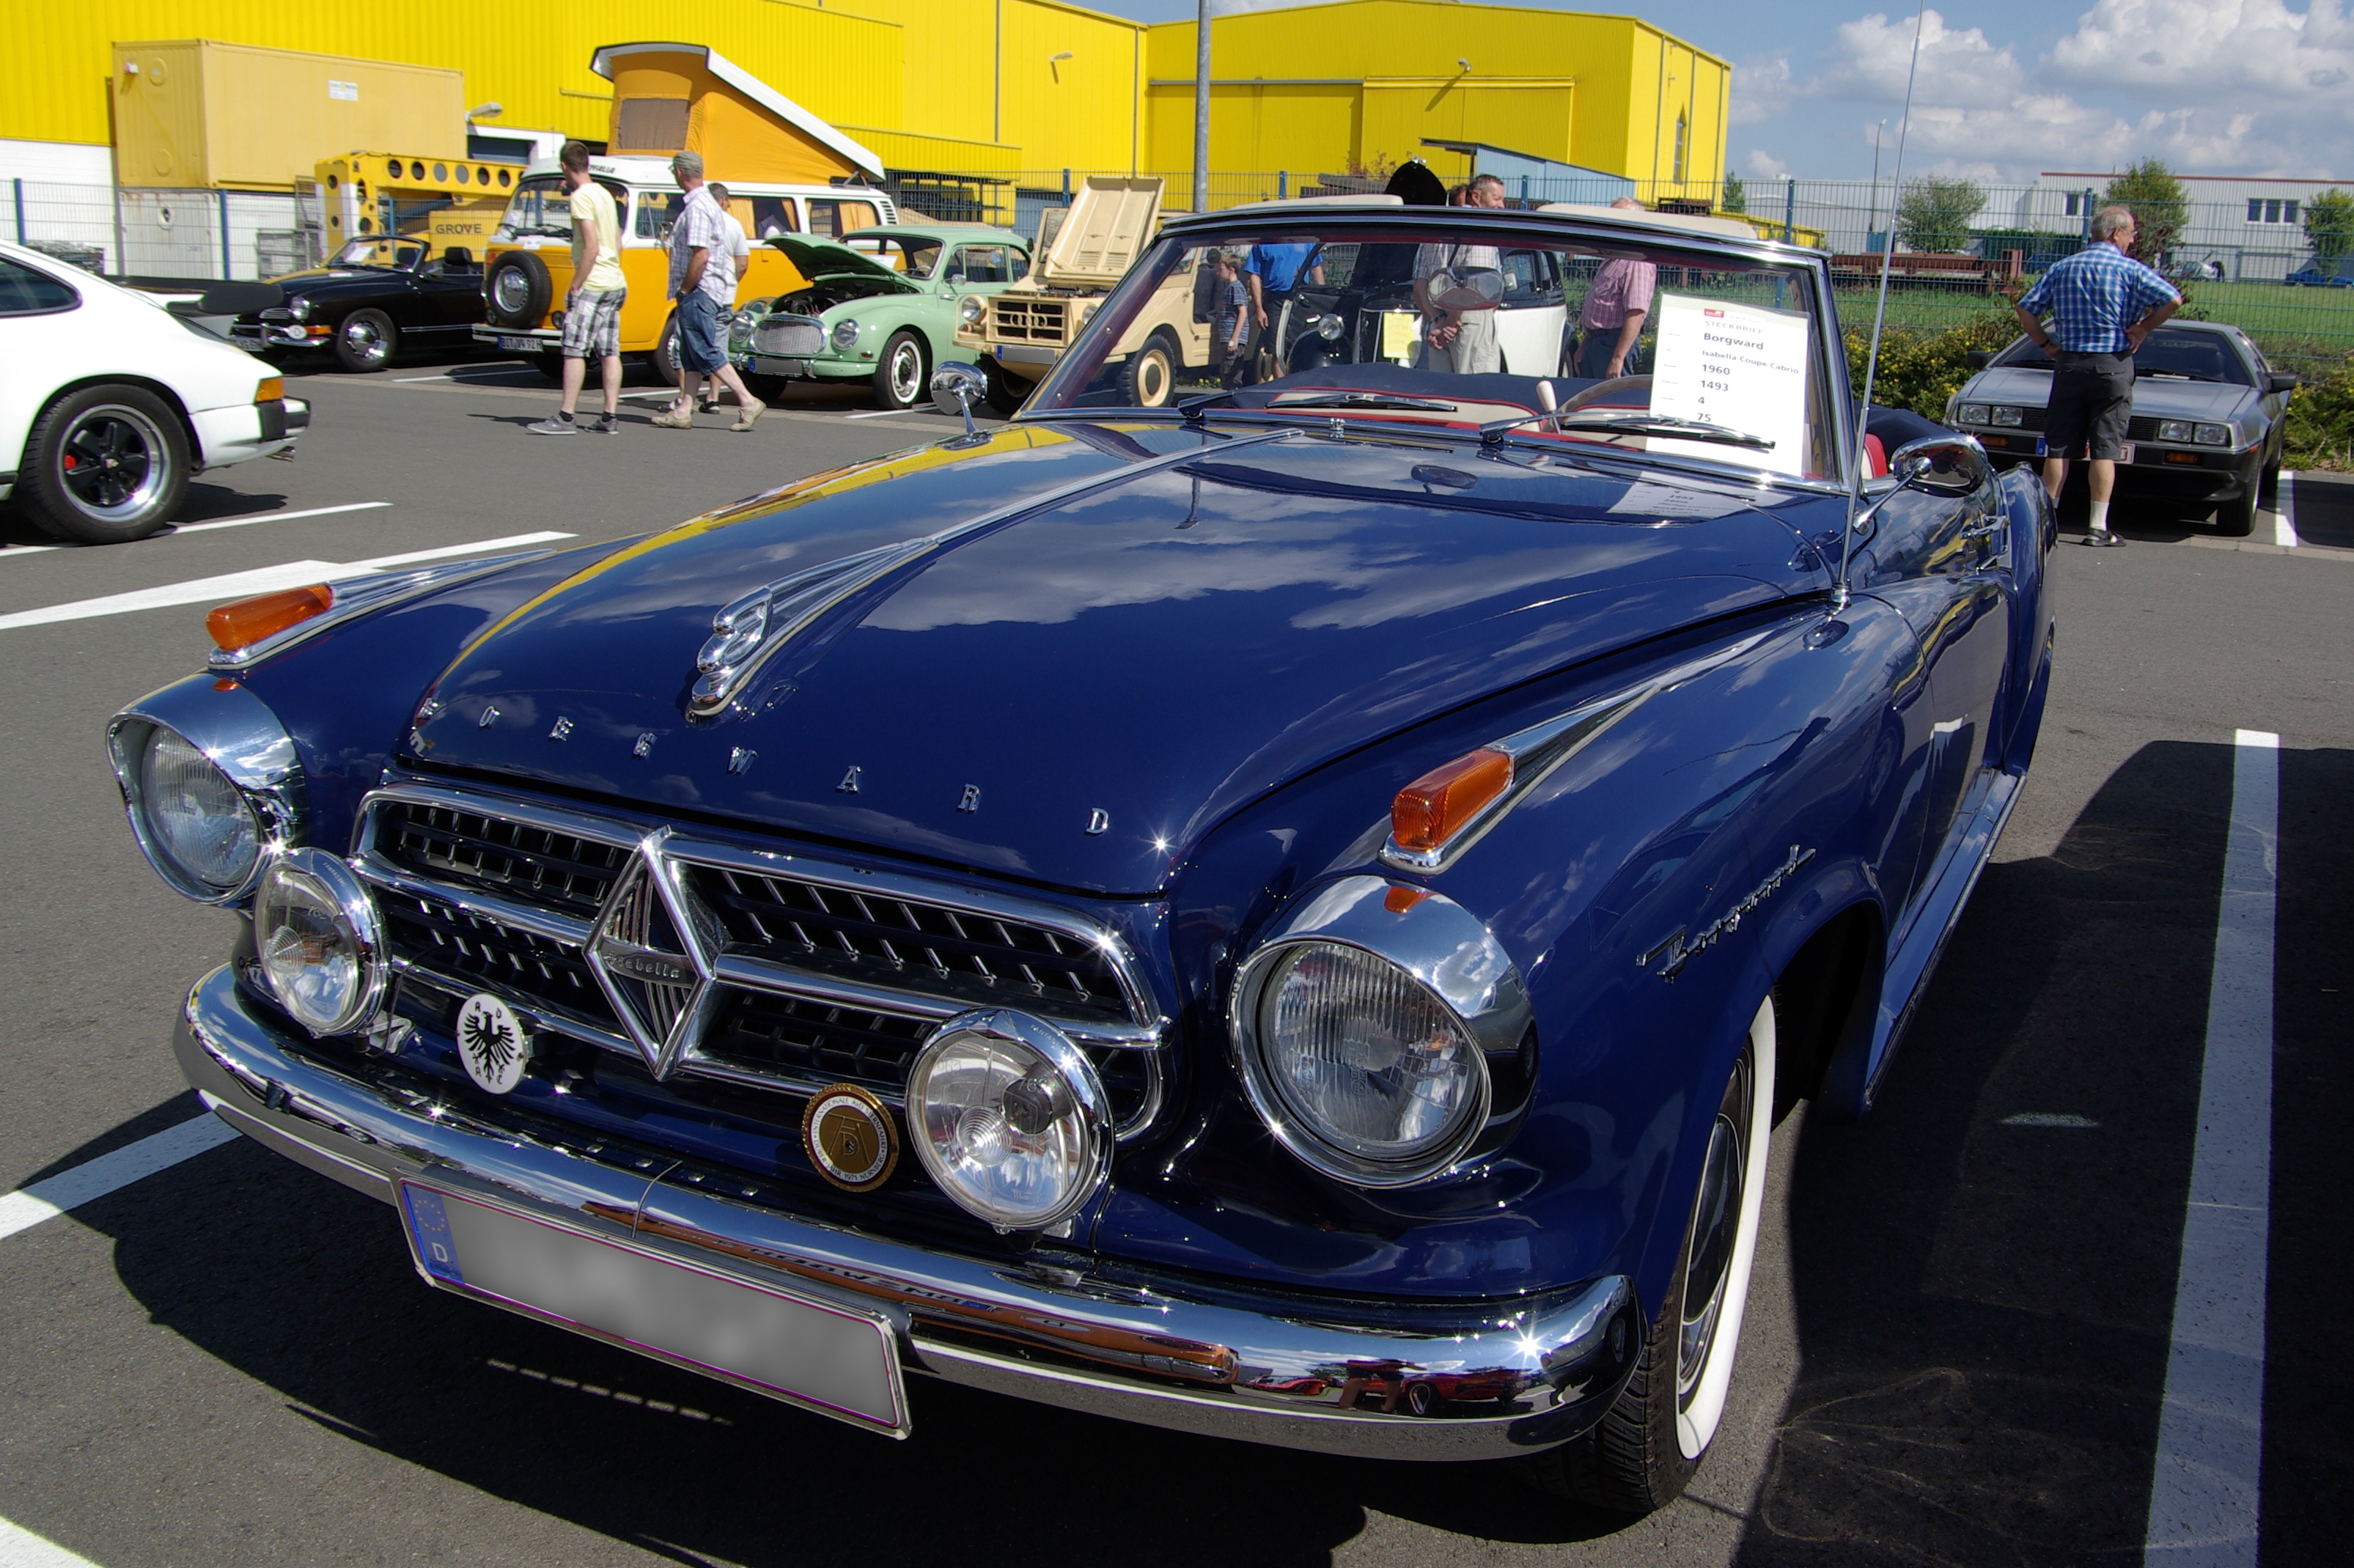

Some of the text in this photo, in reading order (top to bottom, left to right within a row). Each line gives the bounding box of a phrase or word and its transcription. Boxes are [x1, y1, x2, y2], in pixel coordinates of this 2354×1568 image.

[435, 224, 482, 234] GROVE
[1704, 320, 1763, 335] STECKBRIEF
[501, 337, 513, 347] BIT
[1703, 332, 1764, 350] Borgward
[1702, 350, 1799, 374] Isabella Coupe Cabrio
[1702, 364, 1730, 375] 1960
[1700, 380, 1729, 391] 1493
[1697, 396, 1705, 404] 4
[1696, 413, 1711, 422] 75
[603, 950, 680, 979] Isabella
[812, 1097, 849, 1134] INTERNATIONALE
[864, 1108, 886, 1149] STERNFAHRT
[432, 1242, 449, 1262] D
